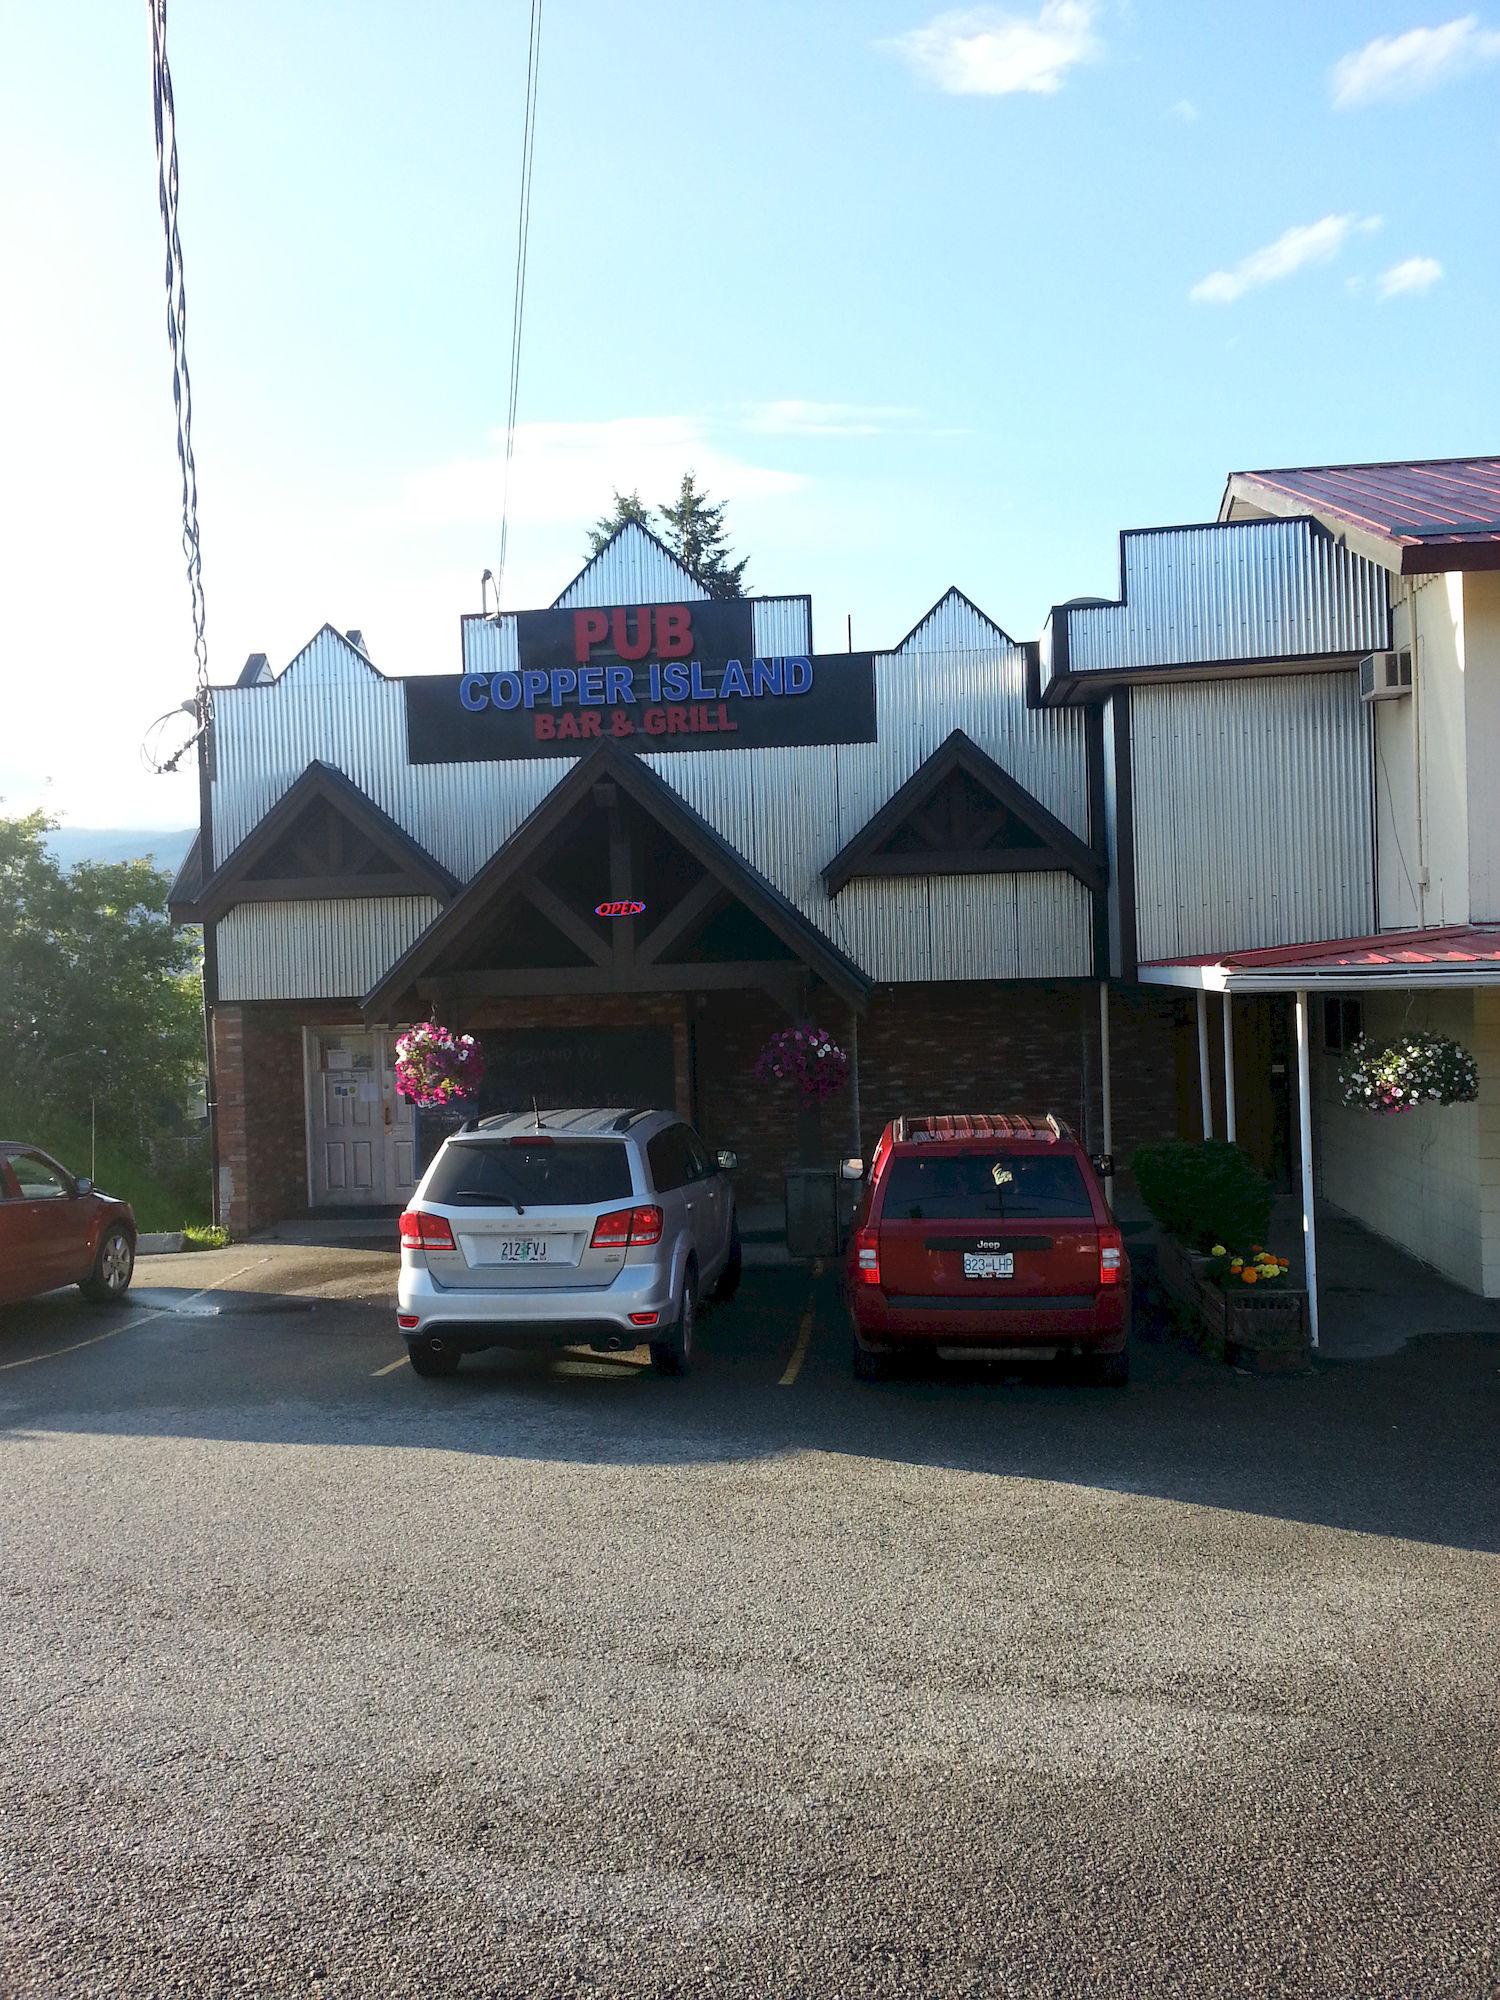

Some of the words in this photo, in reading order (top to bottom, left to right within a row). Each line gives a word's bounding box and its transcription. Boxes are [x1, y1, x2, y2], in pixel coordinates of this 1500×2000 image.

[573, 606, 694, 662] PUB
[460, 665, 635, 711] COPPER
[649, 656, 814, 702] ISLAND
[534, 708, 603, 741] BAR
[611, 709, 636, 737] &
[643, 704, 738, 735] GRILL
[598, 901, 643, 916] OPEN
[501, 1242, 520, 1256] 212
[526, 1242, 546, 1256] FVJ
[976, 1240, 1001, 1250] Jeep
